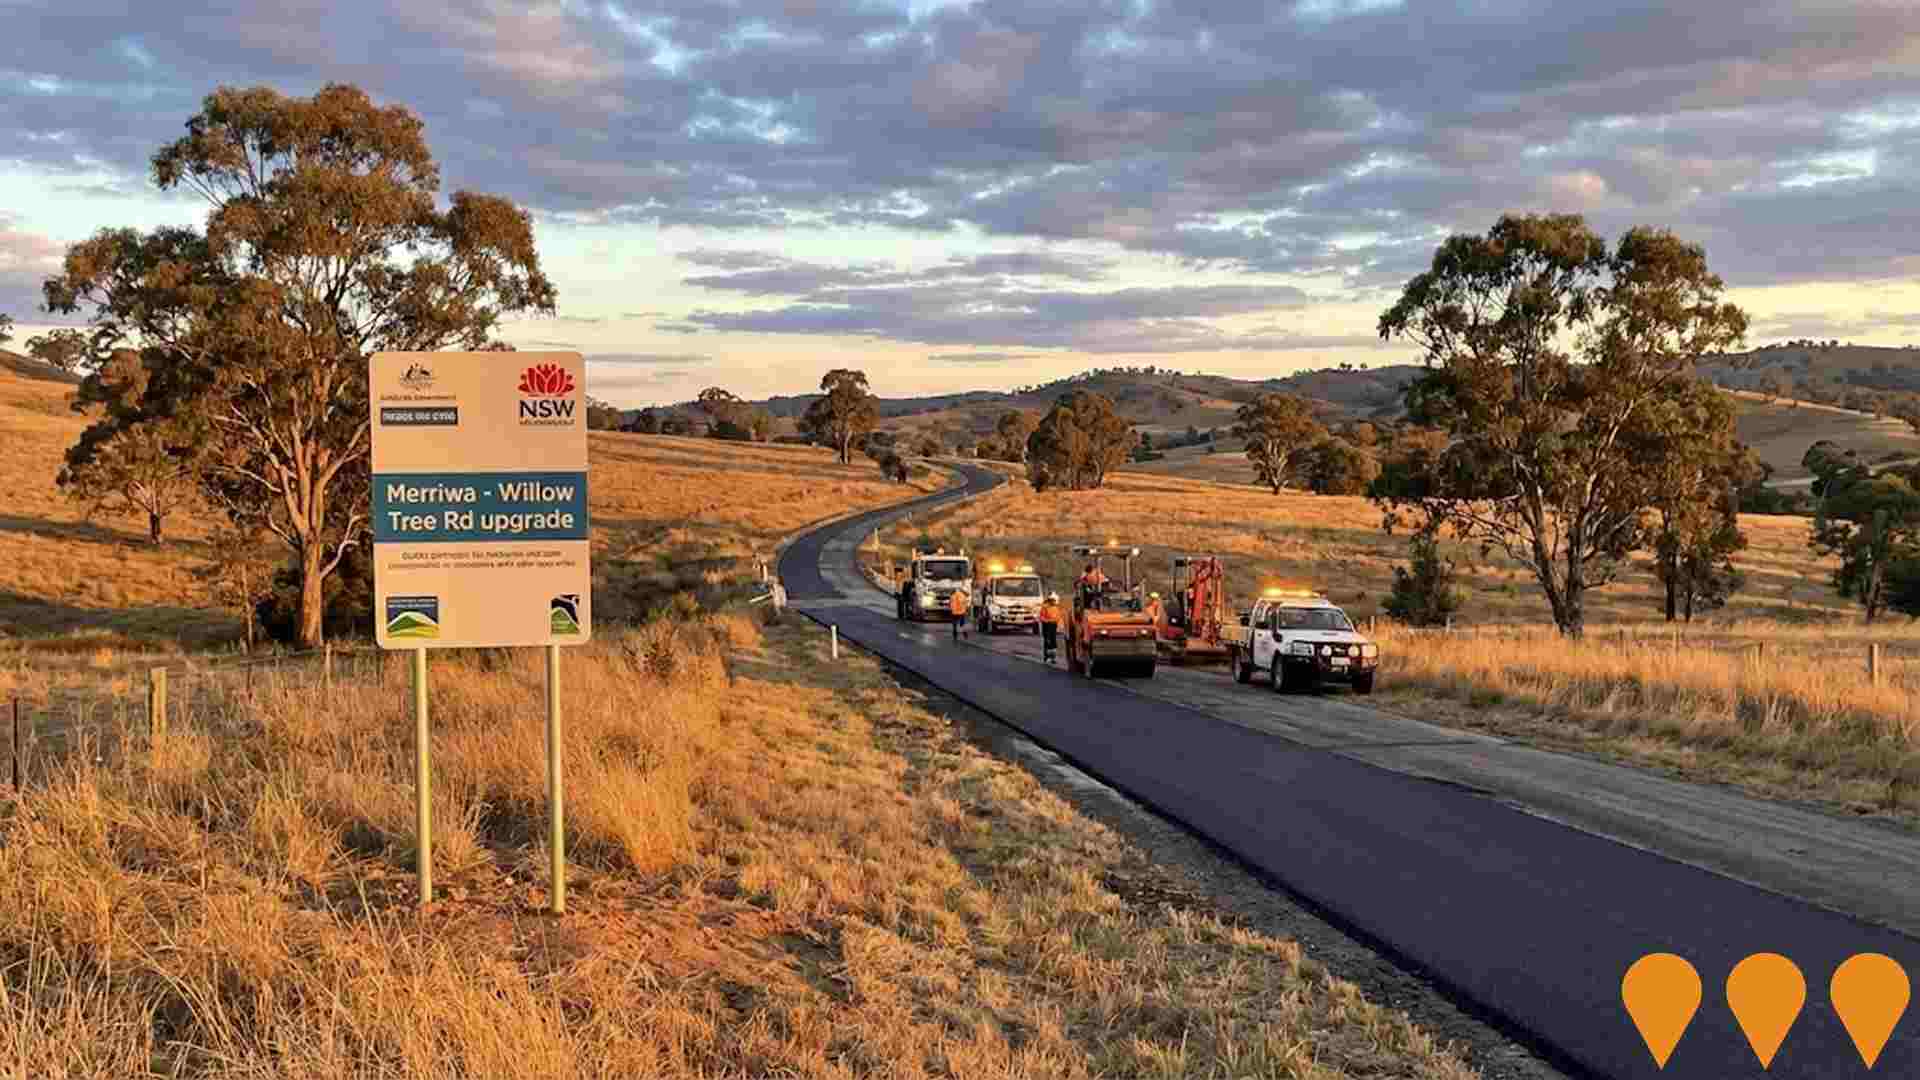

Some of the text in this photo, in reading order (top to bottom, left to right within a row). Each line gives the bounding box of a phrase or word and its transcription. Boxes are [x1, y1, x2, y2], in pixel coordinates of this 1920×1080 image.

[519, 400, 575, 417] NSW
[387, 484, 476, 503] Merriwa
[498, 482, 574, 501] Willow
[388, 509, 574, 533] Tree Rd upgrade
